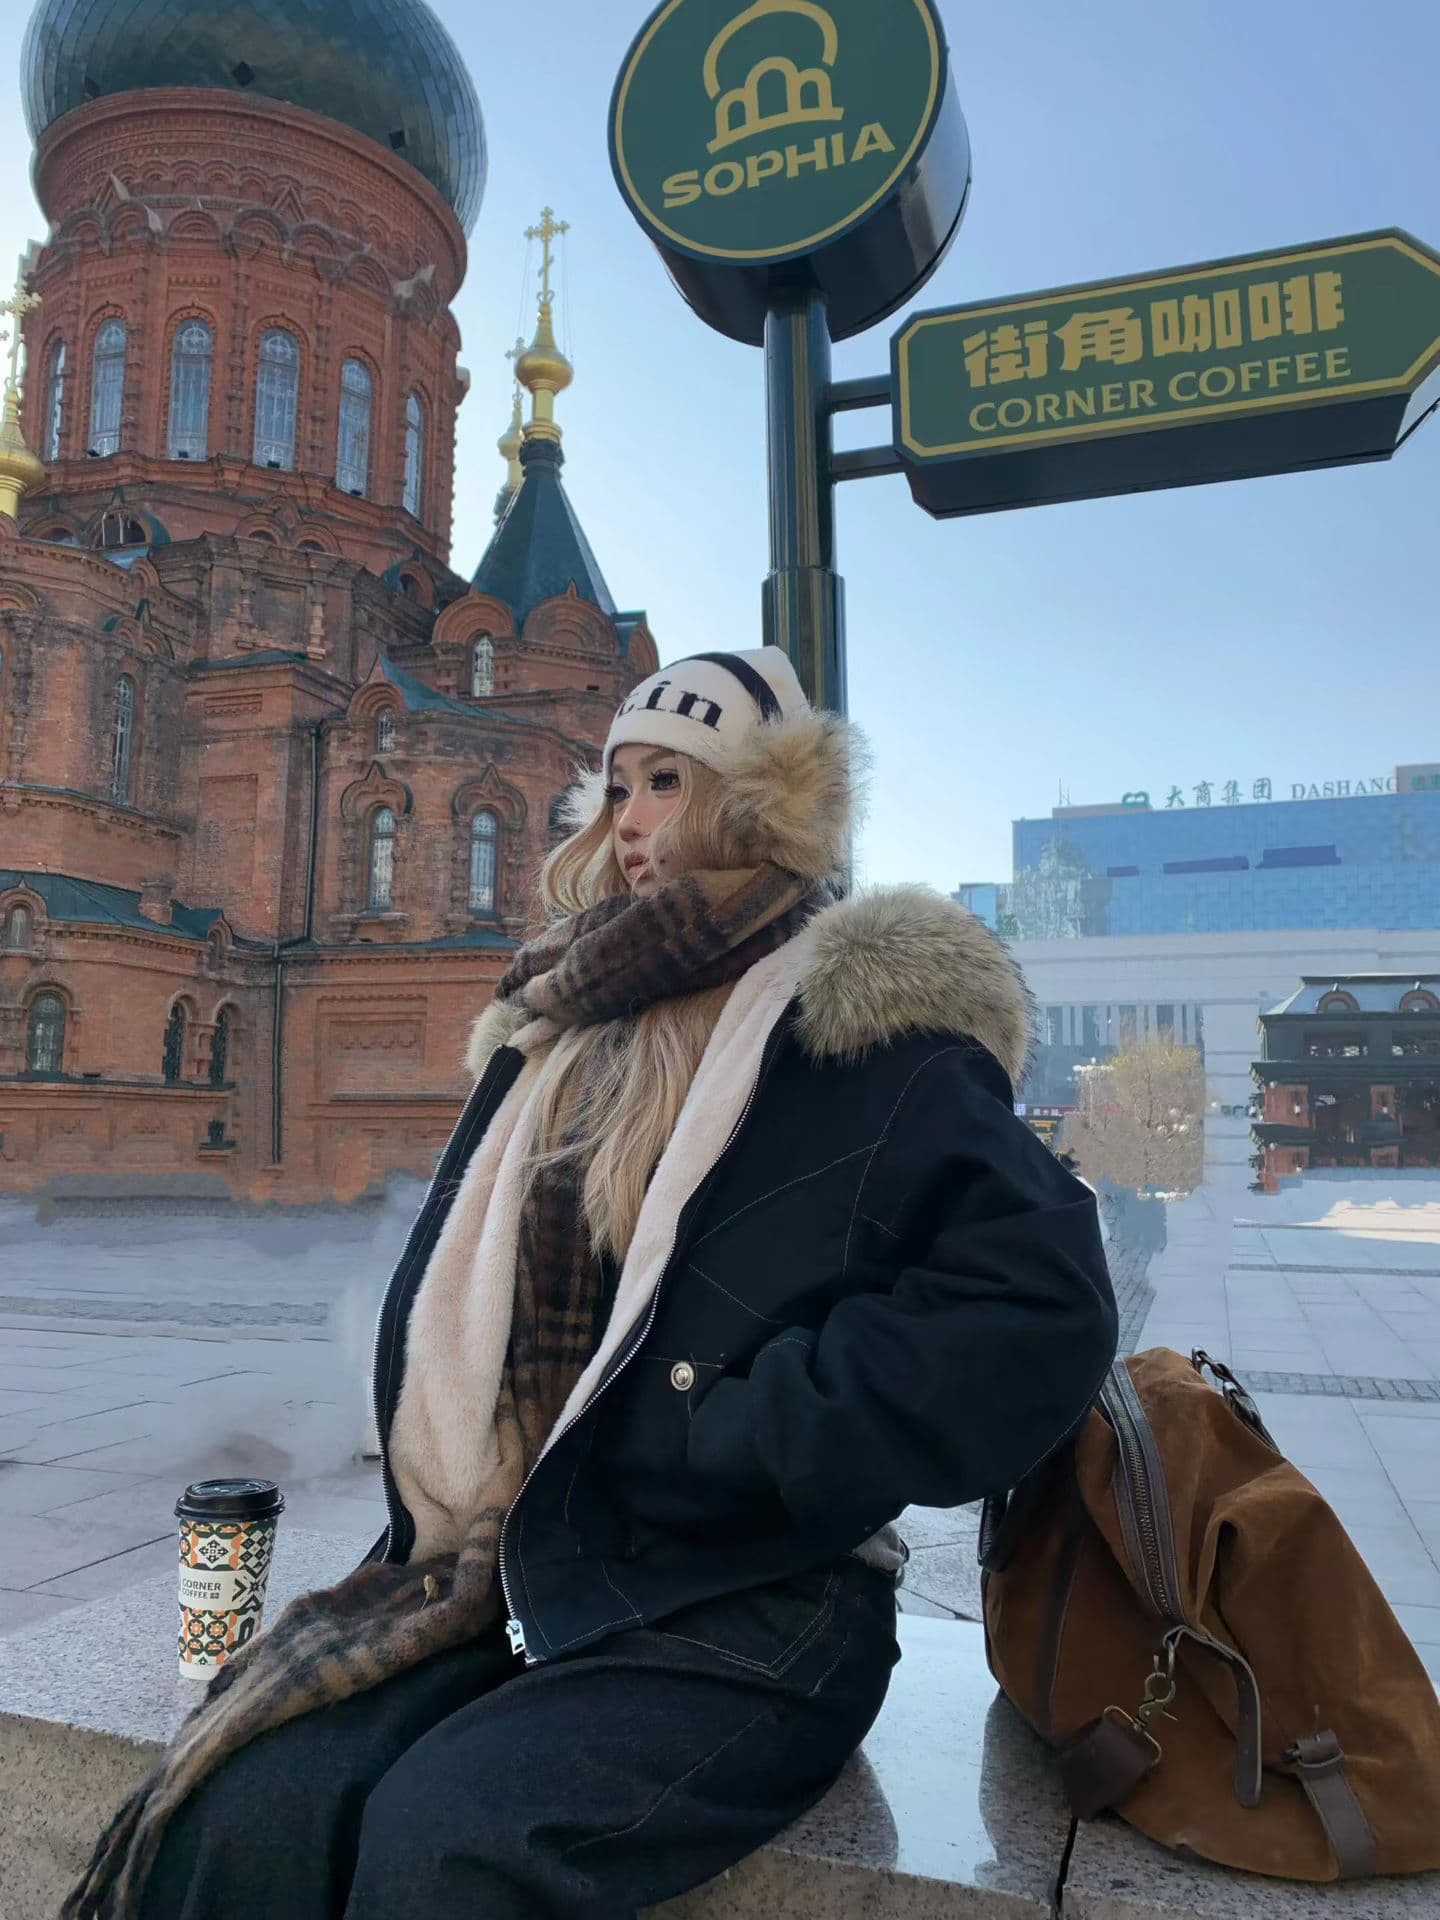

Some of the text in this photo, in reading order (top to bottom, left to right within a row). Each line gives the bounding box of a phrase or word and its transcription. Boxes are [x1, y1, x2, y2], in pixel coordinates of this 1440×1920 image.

[662, 121, 896, 209] SOPHIA
[963, 271, 1346, 389] 街角咖啡
[968, 346, 1352, 433] CORNER COFFEE
[1165, 777, 1273, 808] 大商集团
[182, 1578, 221, 1591] CORNER
